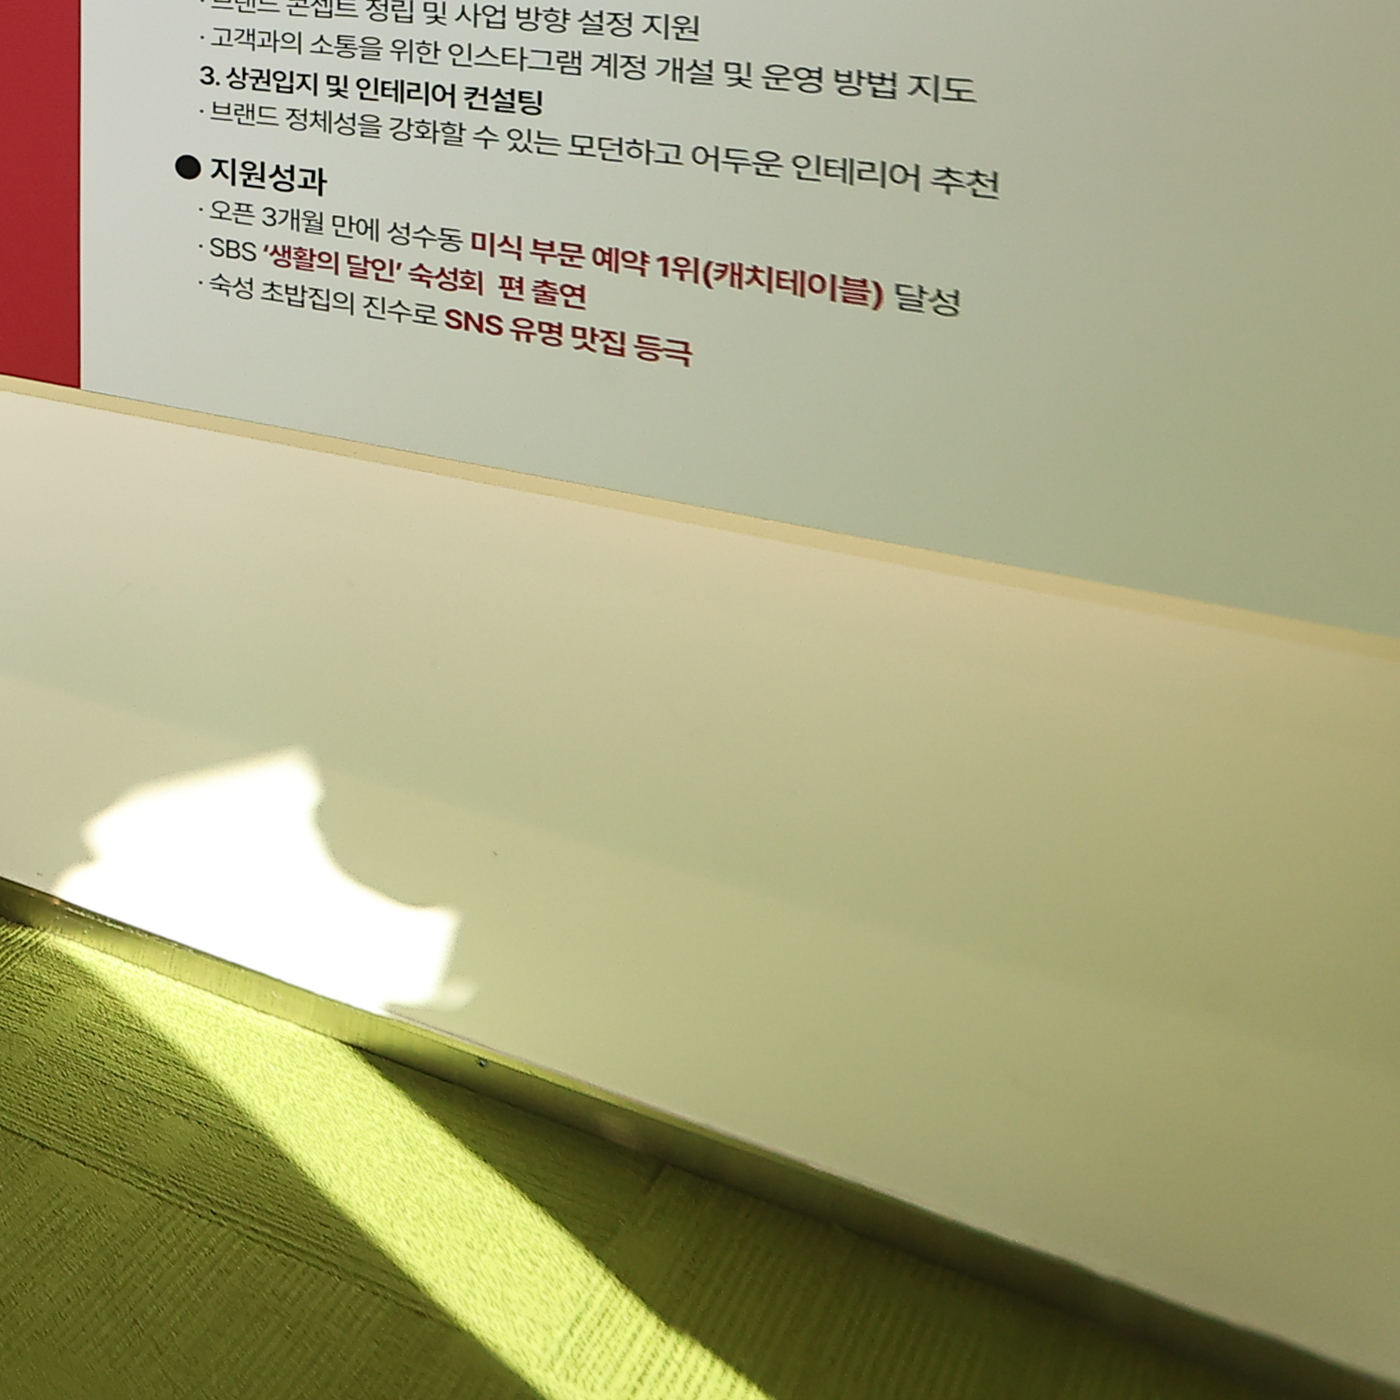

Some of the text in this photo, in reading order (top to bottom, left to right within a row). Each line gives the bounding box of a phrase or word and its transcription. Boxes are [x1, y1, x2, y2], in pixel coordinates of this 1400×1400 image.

[211, 158, 327, 196] 지원성과
[210, 201, 959, 316] 오픈 3개월 만에 성수동 미식 부문 예약 1위(캐치테이블) 달성
[210, 238, 256, 261] SBS
[408, 263, 483, 296] 숙성회
[498, 275, 524, 301] 편
[531, 280, 586, 310] 출연
[210, 273, 693, 367] 숙성 초밥집의 진수로 SNS 유명 맛집 등극
